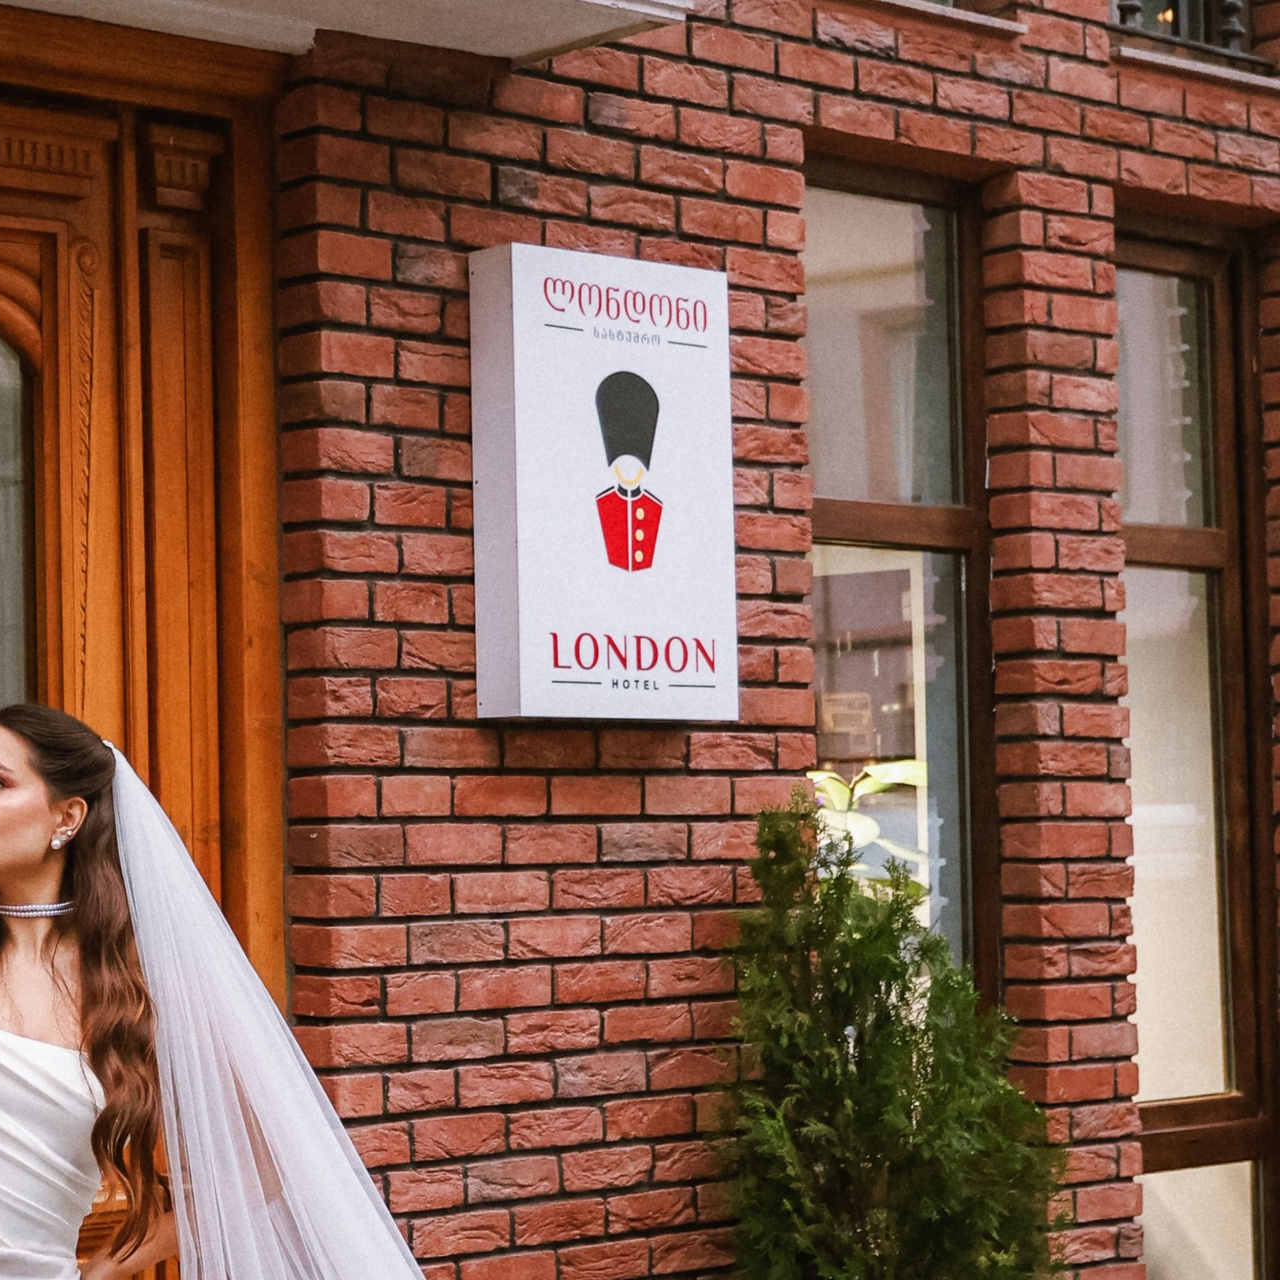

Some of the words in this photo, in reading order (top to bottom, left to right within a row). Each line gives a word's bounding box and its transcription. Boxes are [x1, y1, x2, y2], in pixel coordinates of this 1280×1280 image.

[543, 277, 708, 332] ლონდონი
[593, 326, 661, 346] სასტუმრო
[550, 632, 716, 674] LONDON
[612, 679, 659, 691] HOTEL
